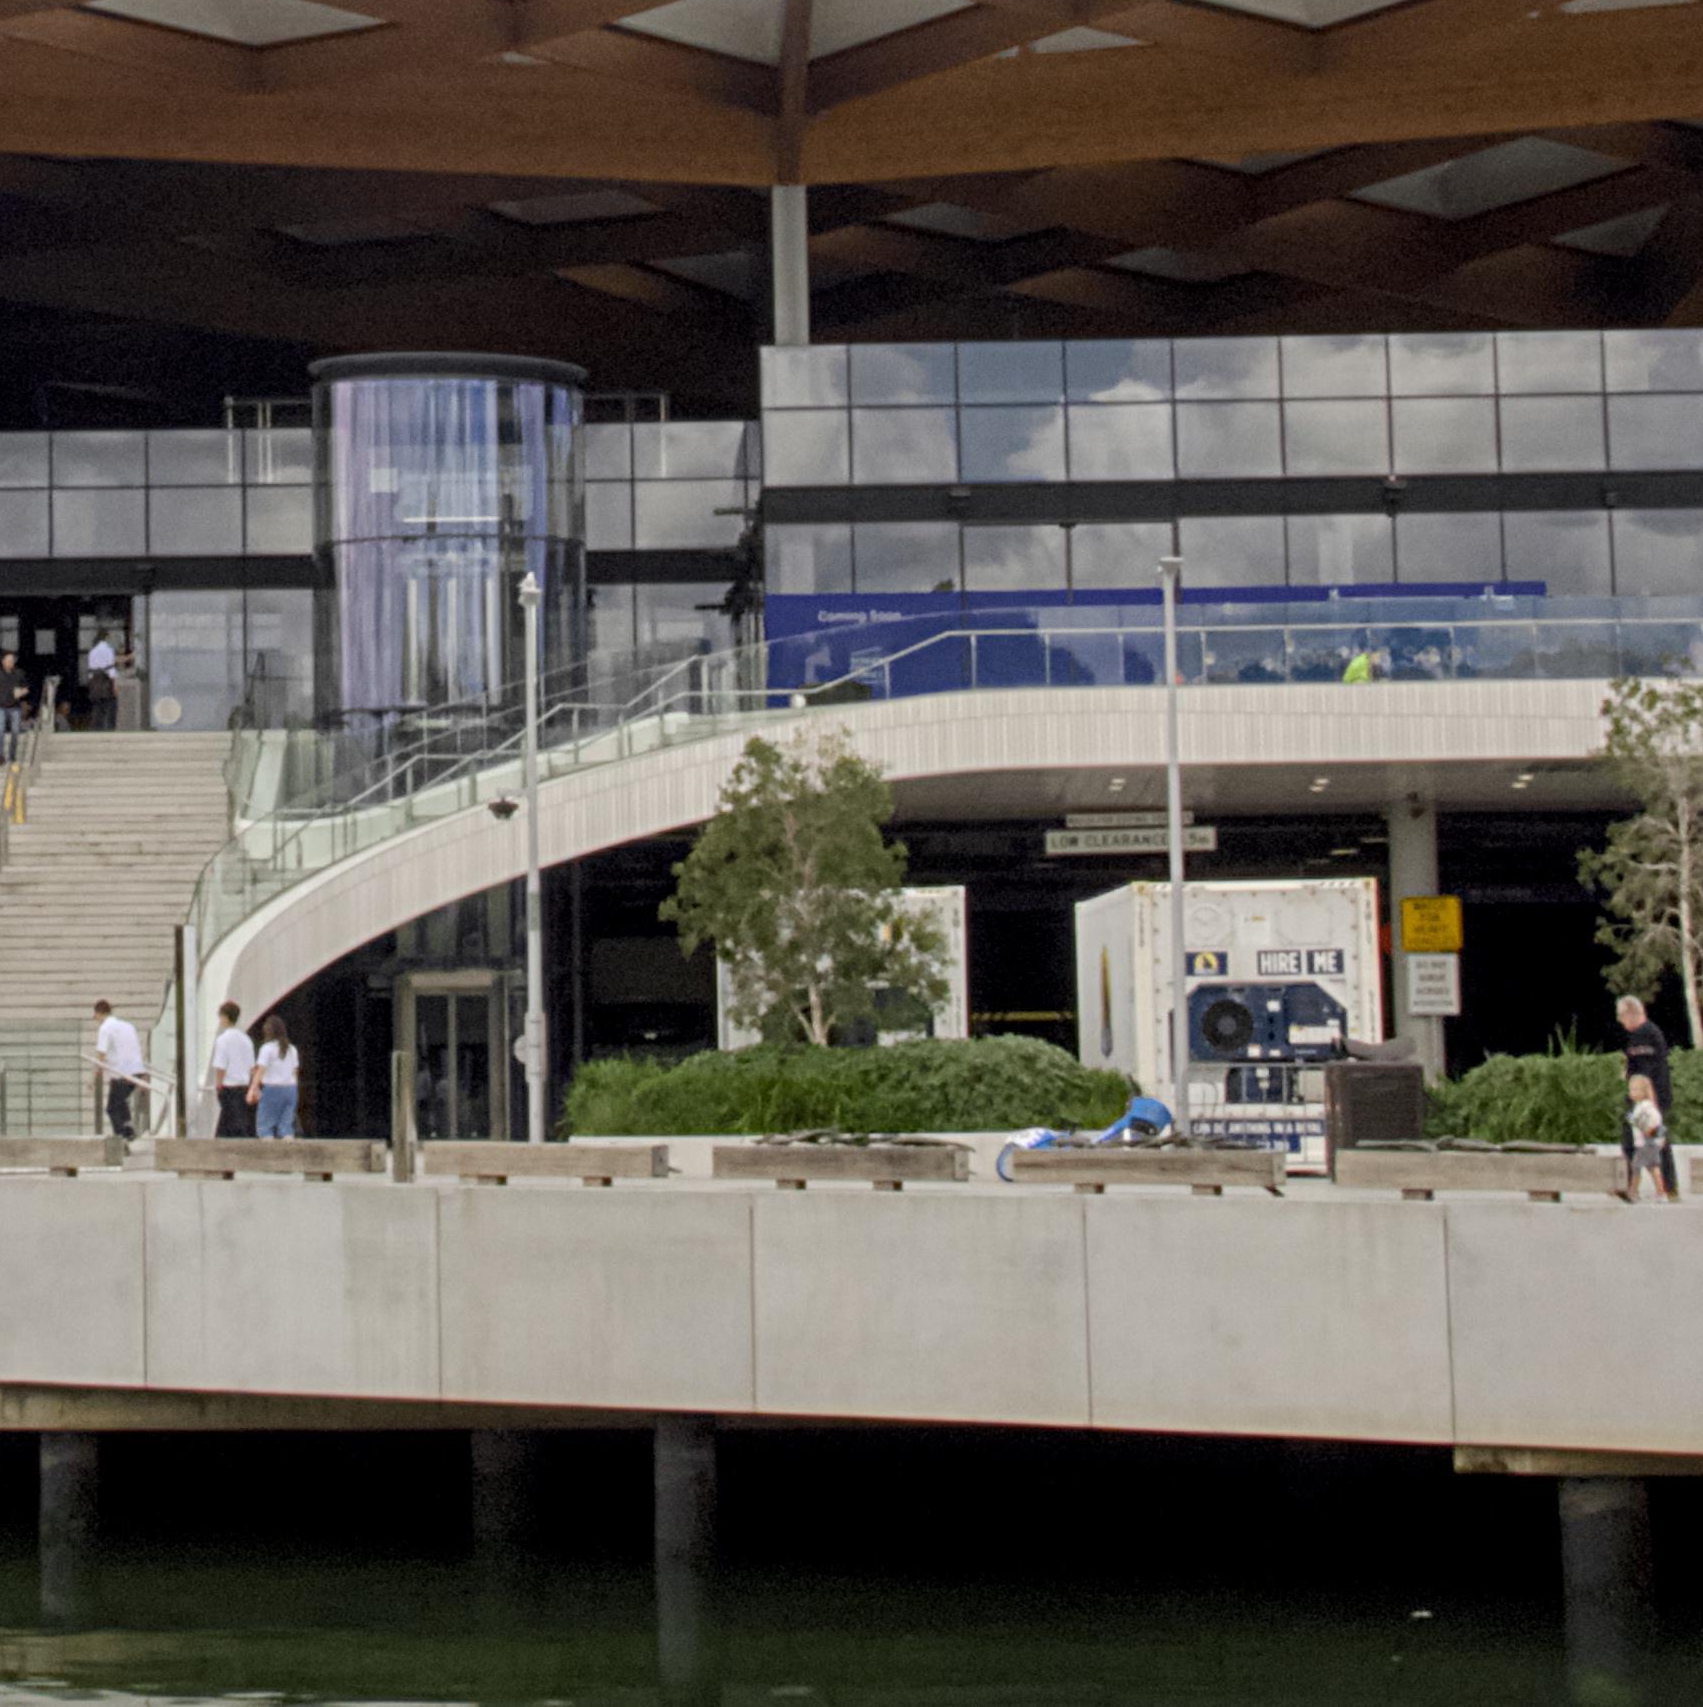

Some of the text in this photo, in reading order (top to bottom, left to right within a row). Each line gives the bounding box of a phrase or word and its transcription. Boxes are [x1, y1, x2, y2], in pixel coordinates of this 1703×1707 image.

[817, 609, 903, 625] Coming Soon
[1049, 835, 1079, 850] LOW
[1259, 952, 1339, 974] HIRE ME
